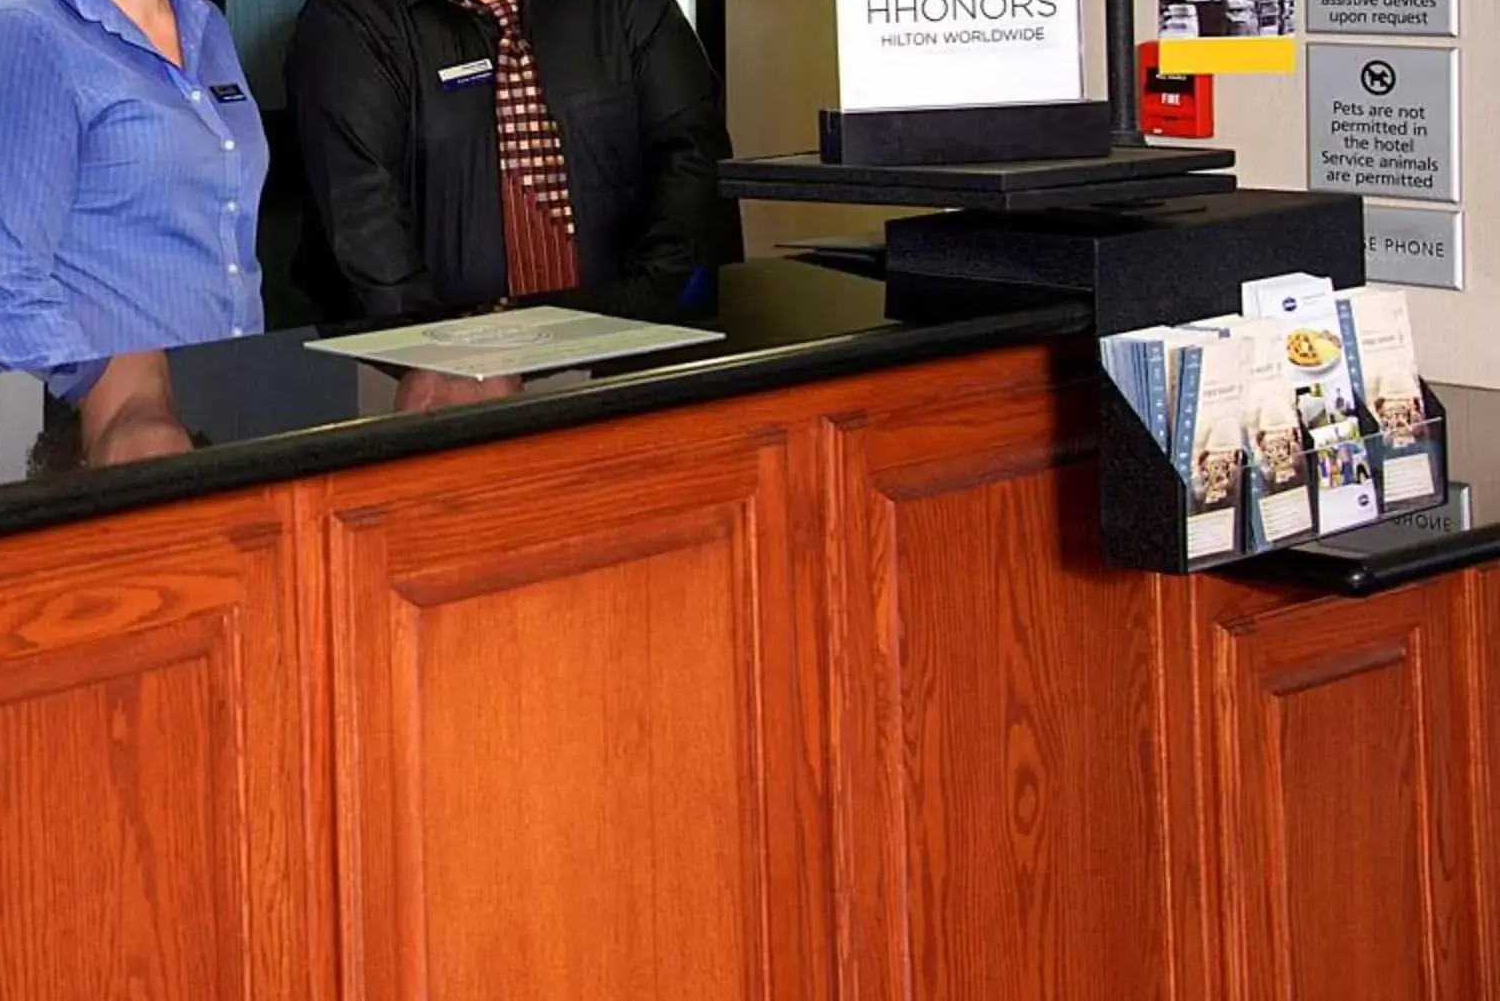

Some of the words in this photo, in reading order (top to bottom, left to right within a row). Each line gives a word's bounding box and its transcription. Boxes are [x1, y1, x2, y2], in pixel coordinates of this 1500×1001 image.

[1329, 11, 1367, 26] upon
[1372, 12, 1428, 26] request
[881, 31, 938, 48] HILTON
[943, 26, 1045, 44] WORLDWIDE
[1333, 100, 1364, 116] Pets
[1369, 106, 1393, 117] are
[1398, 106, 1425, 119] not
[1331, 120, 1407, 135] permitted
[1413, 122, 1428, 136] in
[1344, 135, 1369, 149] the
[1374, 137, 1415, 152] hotel
[1321, 150, 1375, 167] Service
[1380, 154, 1439, 171] animals
[1326, 171, 1351, 182] are
[1355, 171, 1433, 188] permitted
[1385, 238, 1444, 258] PHONE
